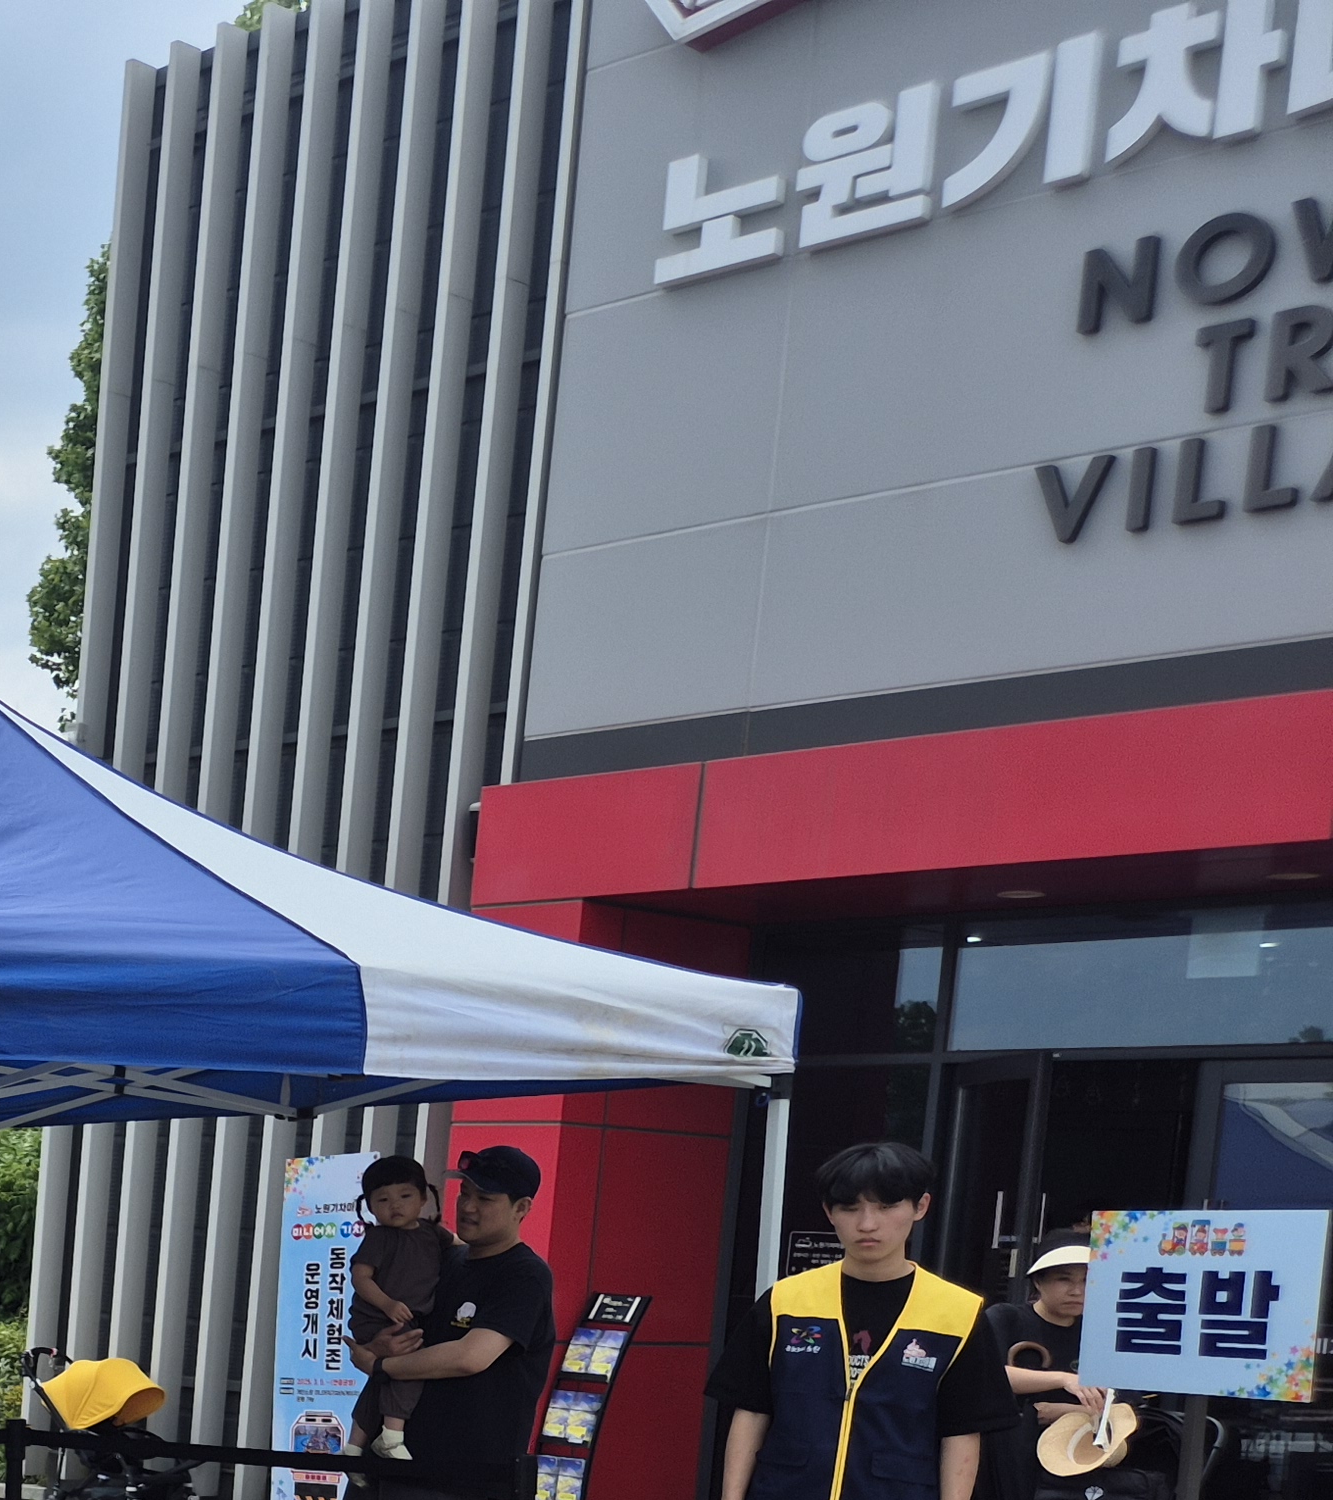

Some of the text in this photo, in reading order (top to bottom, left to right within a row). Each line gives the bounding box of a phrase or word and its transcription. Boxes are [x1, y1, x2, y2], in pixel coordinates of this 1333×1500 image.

[653, 0, 1333, 288] 노원기차
[1034, 424, 1333, 545] VILL
[292, 1224, 336, 1238] 미니어처
[301, 1263, 321, 1360] 운영개시
[325, 1247, 346, 1371] 동작체험존
[1115, 1266, 1280, 1360] 출발
